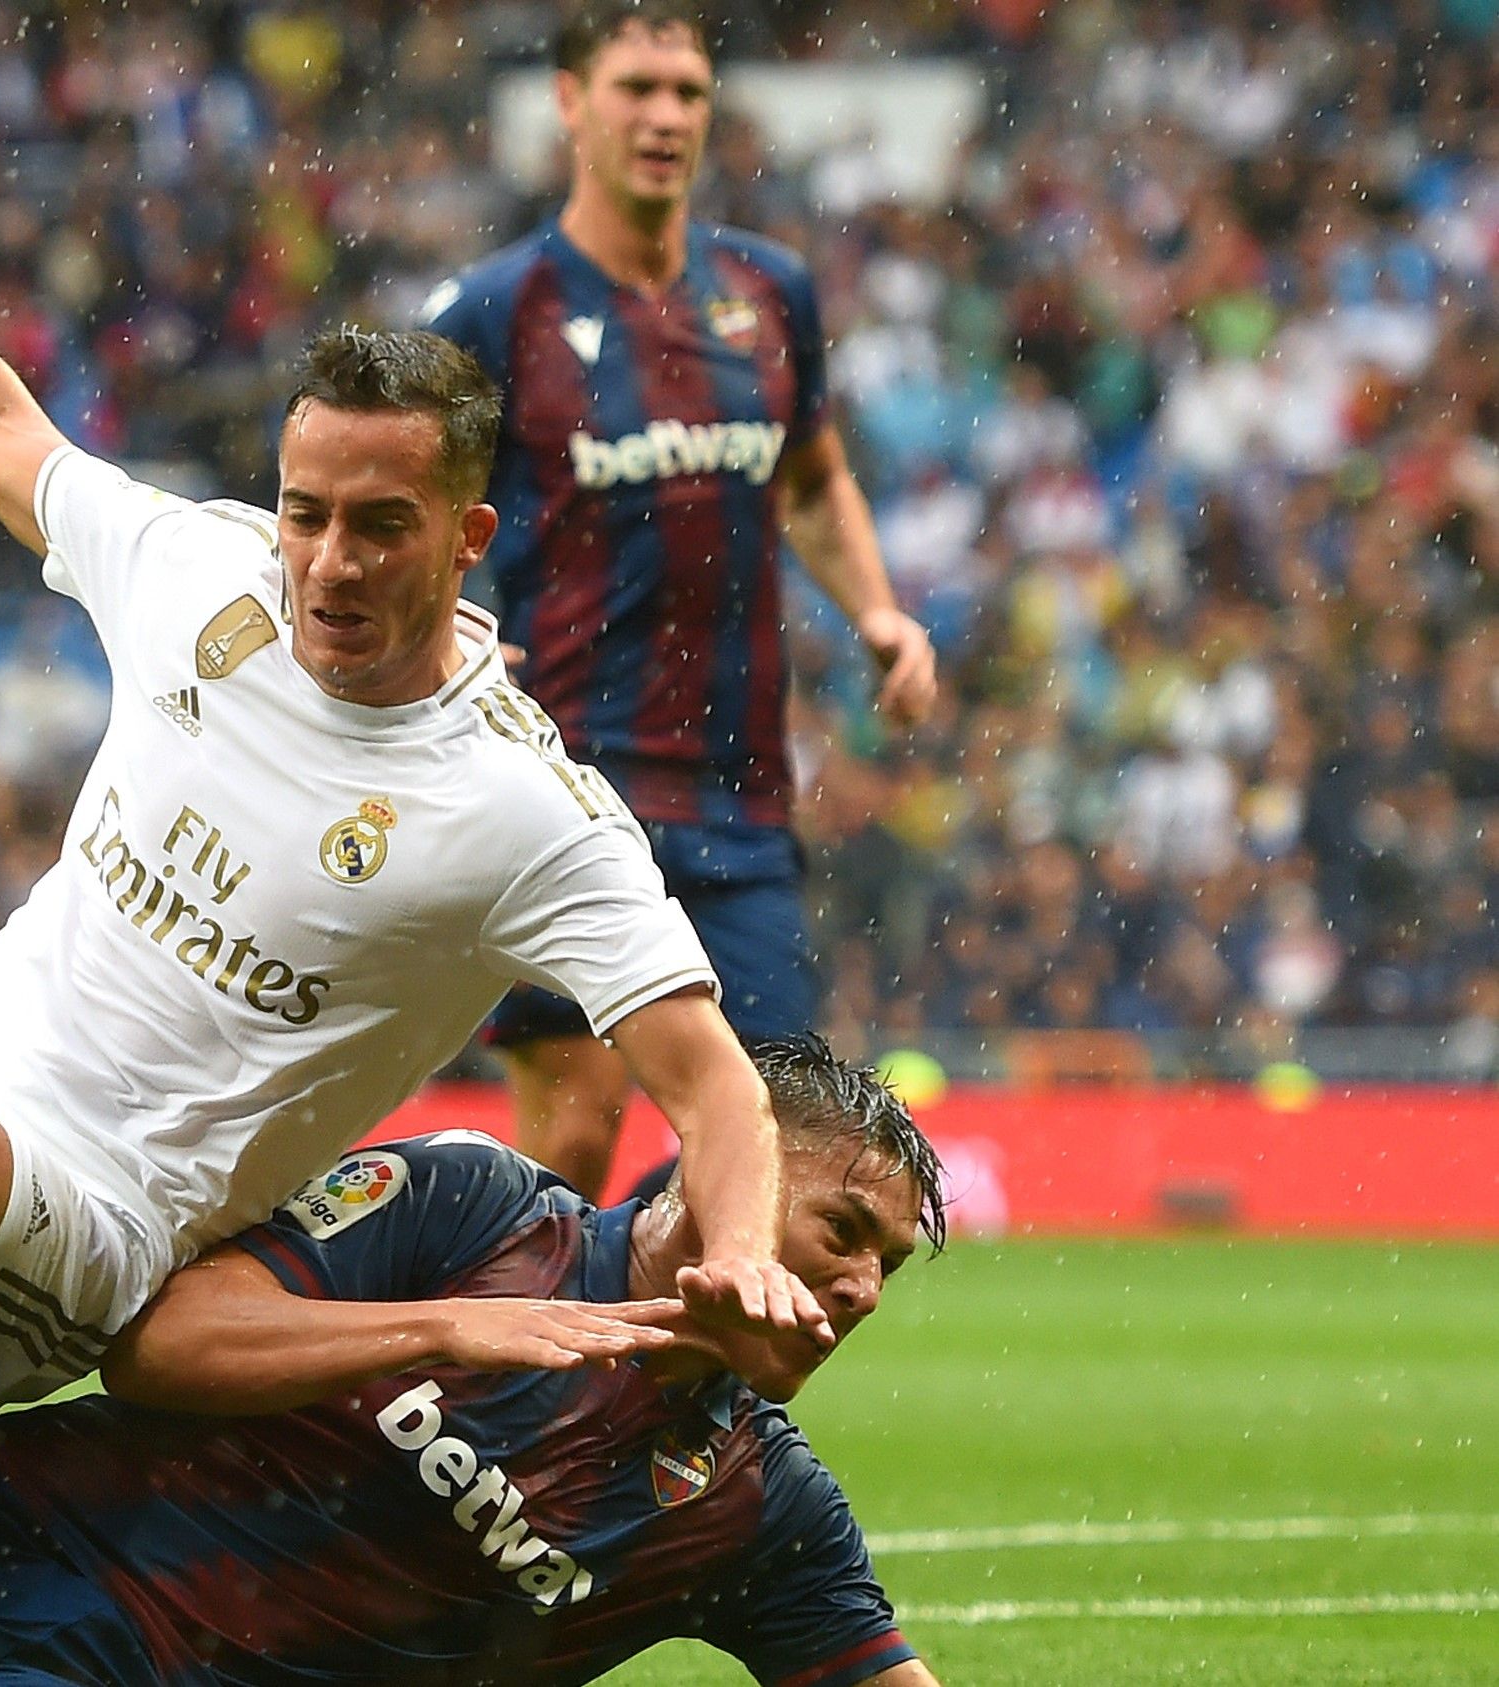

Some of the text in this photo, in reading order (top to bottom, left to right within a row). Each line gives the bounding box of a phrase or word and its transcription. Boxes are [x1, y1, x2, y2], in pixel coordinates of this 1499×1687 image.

[569, 419, 786, 489] betway
[152, 695, 203, 738] adidas
[161, 805, 251, 906] Fly
[79, 786, 330, 1025] Emirates
